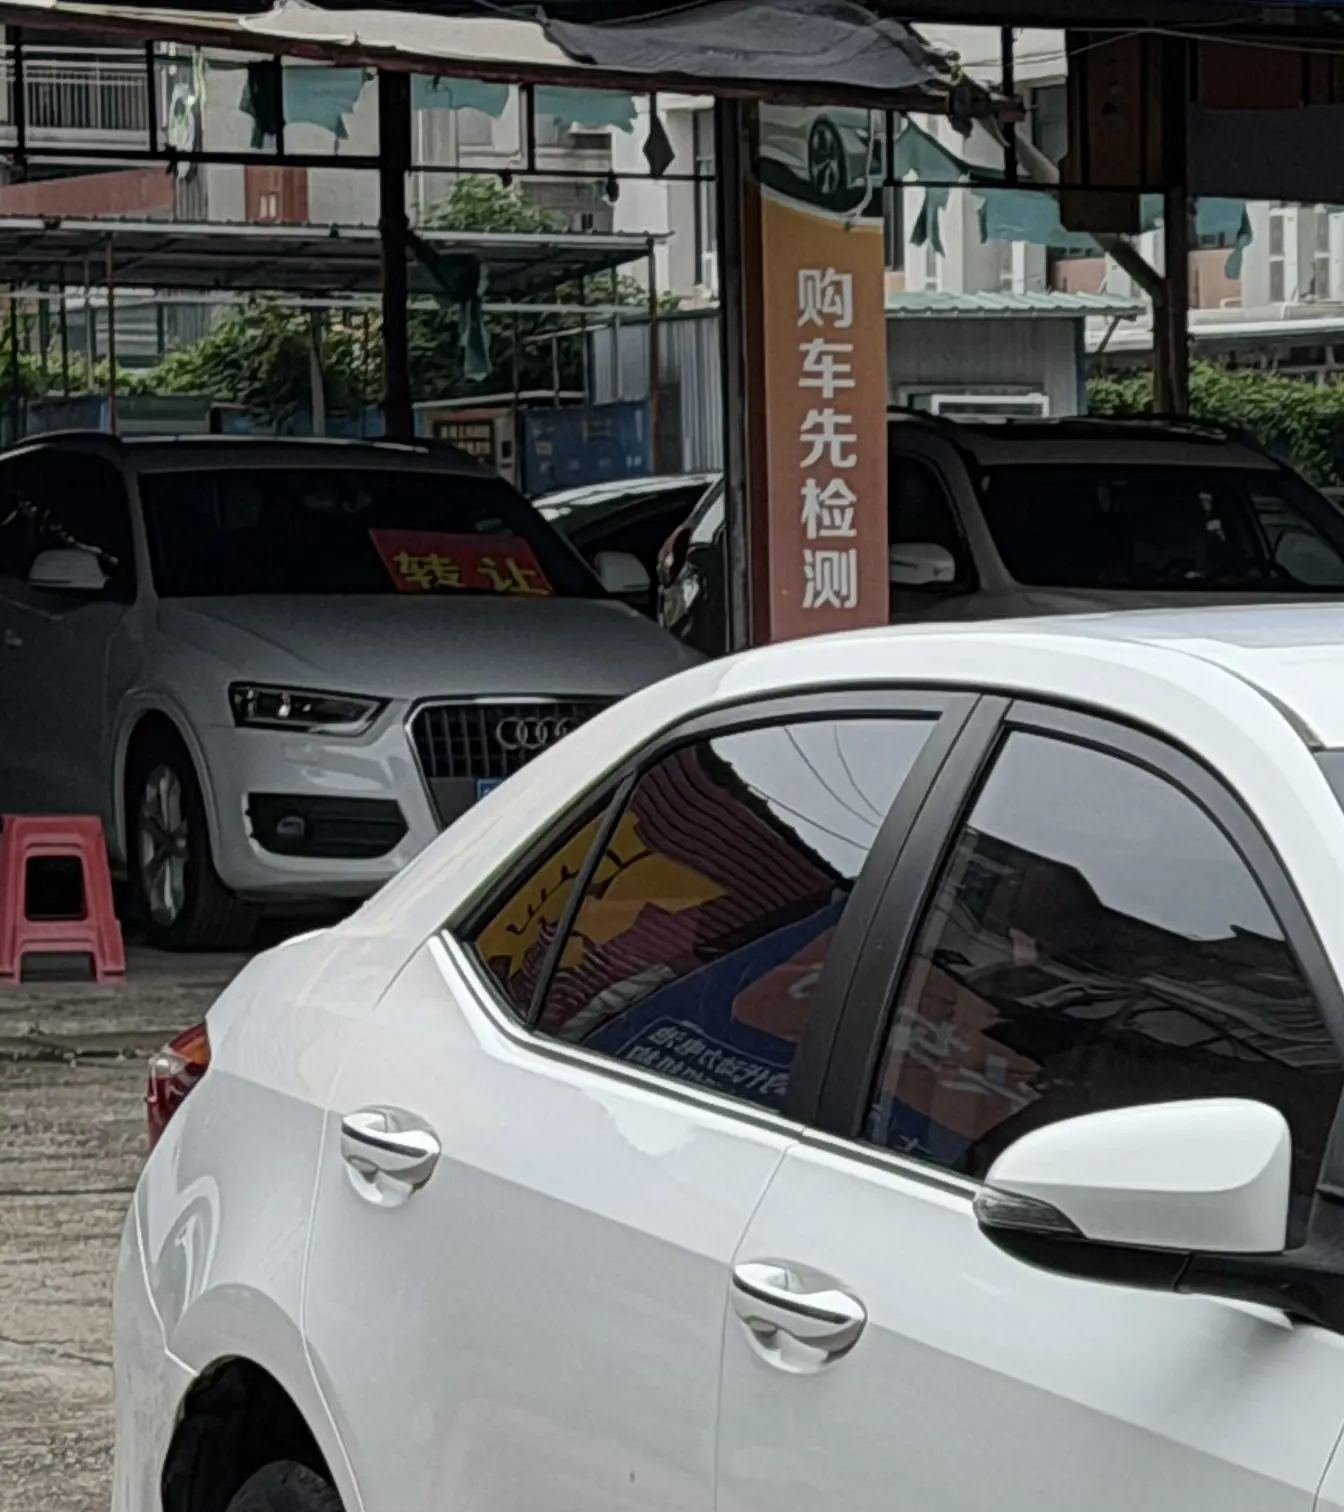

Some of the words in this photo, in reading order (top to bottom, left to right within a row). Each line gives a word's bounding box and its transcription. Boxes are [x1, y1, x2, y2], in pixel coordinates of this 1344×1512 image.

[796, 266, 858, 610] 购车先检测
[393, 551, 553, 596] 转让
